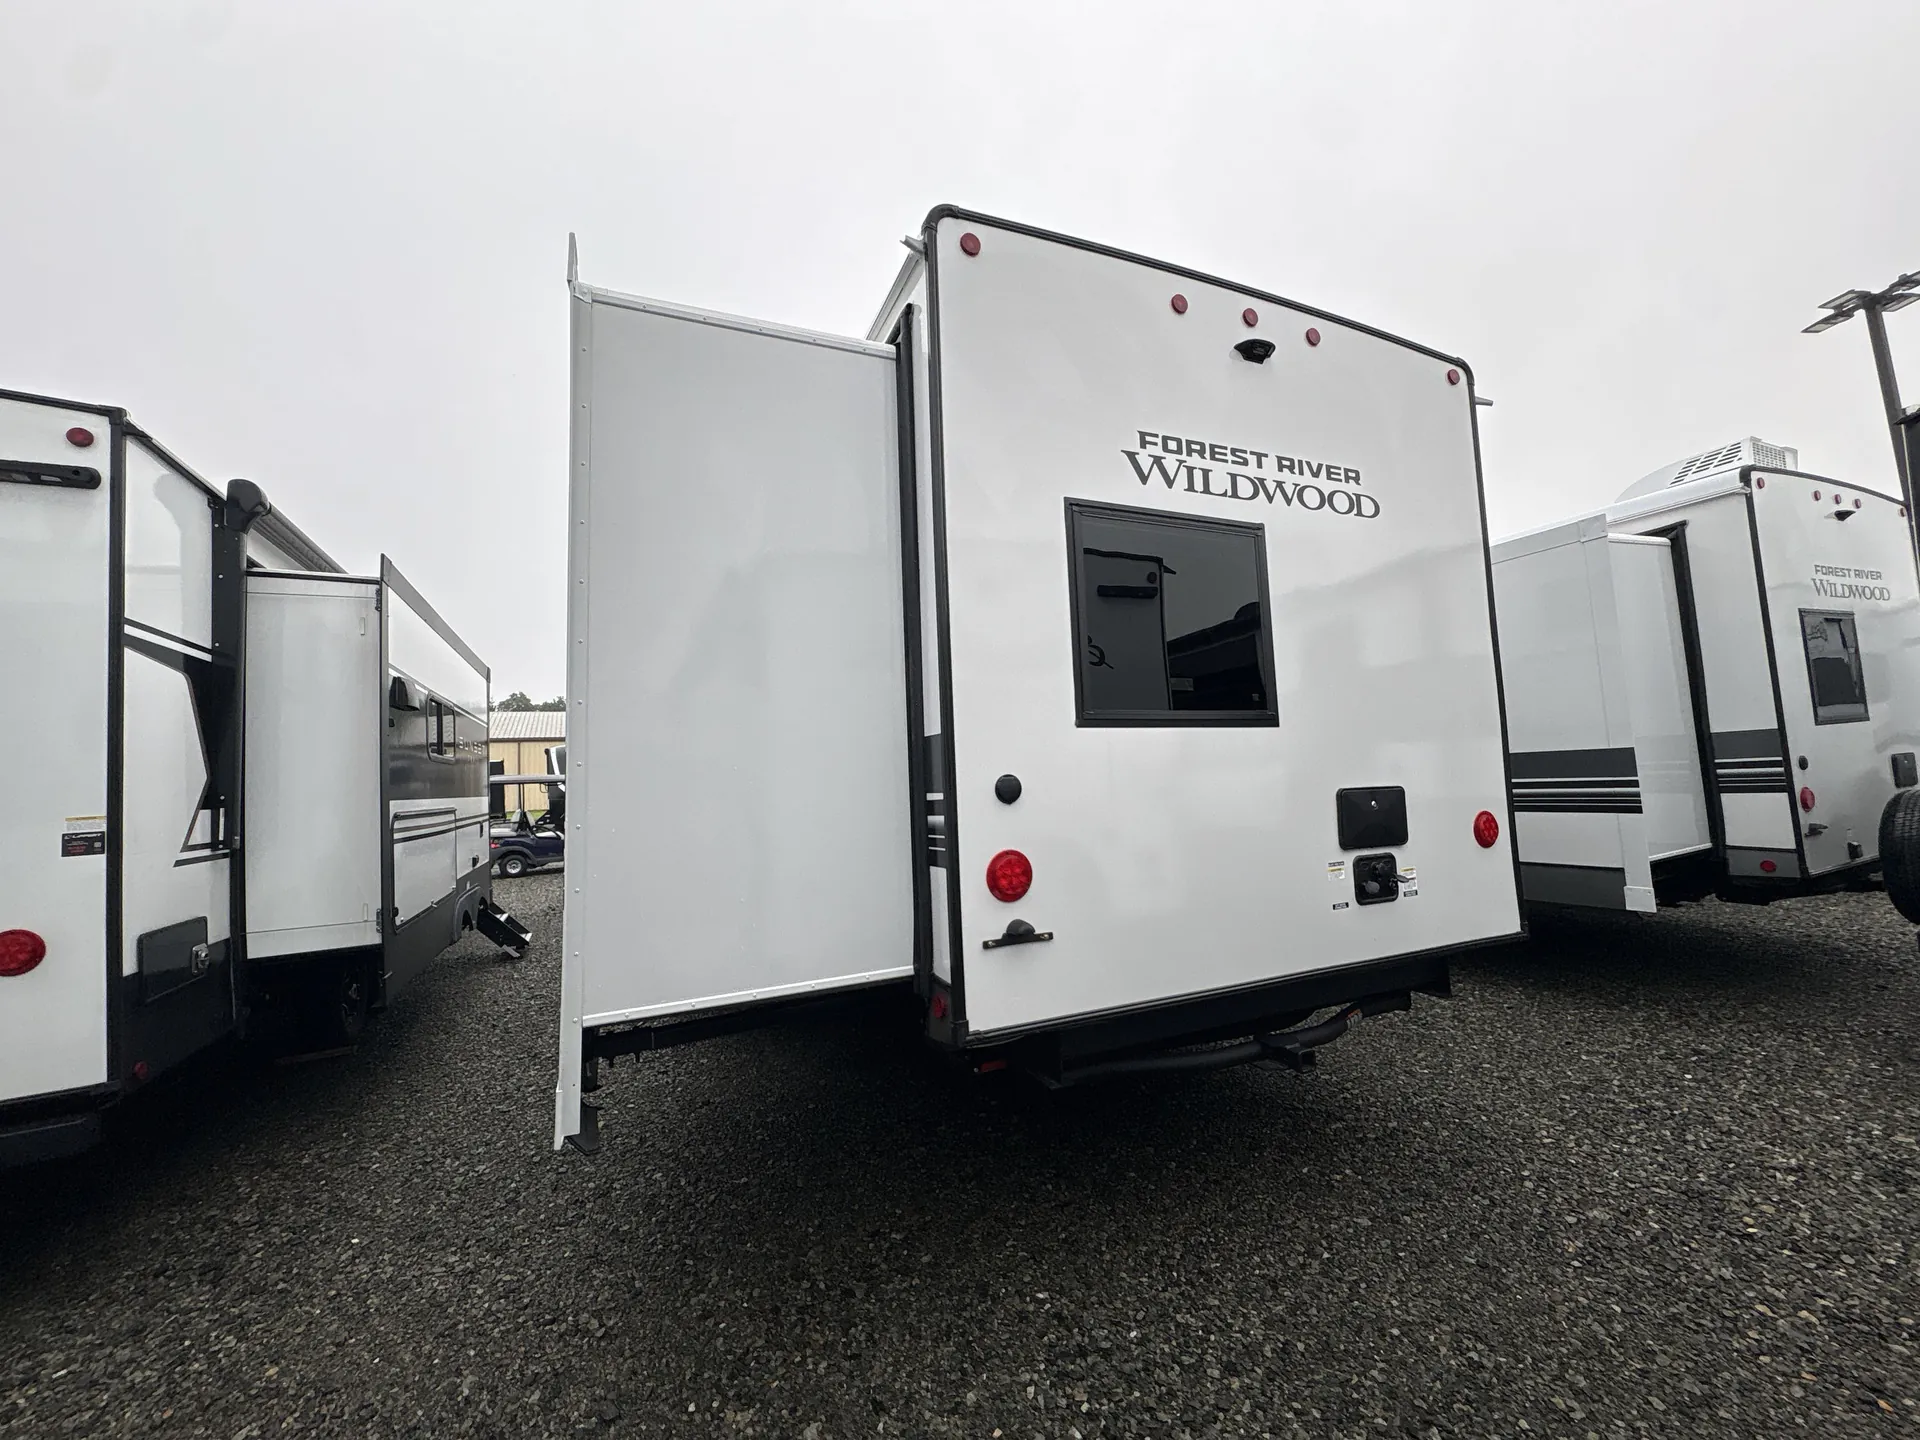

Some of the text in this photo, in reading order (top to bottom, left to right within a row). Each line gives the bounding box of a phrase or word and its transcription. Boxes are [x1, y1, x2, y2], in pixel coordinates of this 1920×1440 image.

[1137, 430, 1362, 486] FOREST RIVER
[1121, 450, 1380, 519] WILDWOOD
[1811, 578, 1891, 601] WILDWOOD
[1814, 564, 1882, 580] FOREST RIVER
